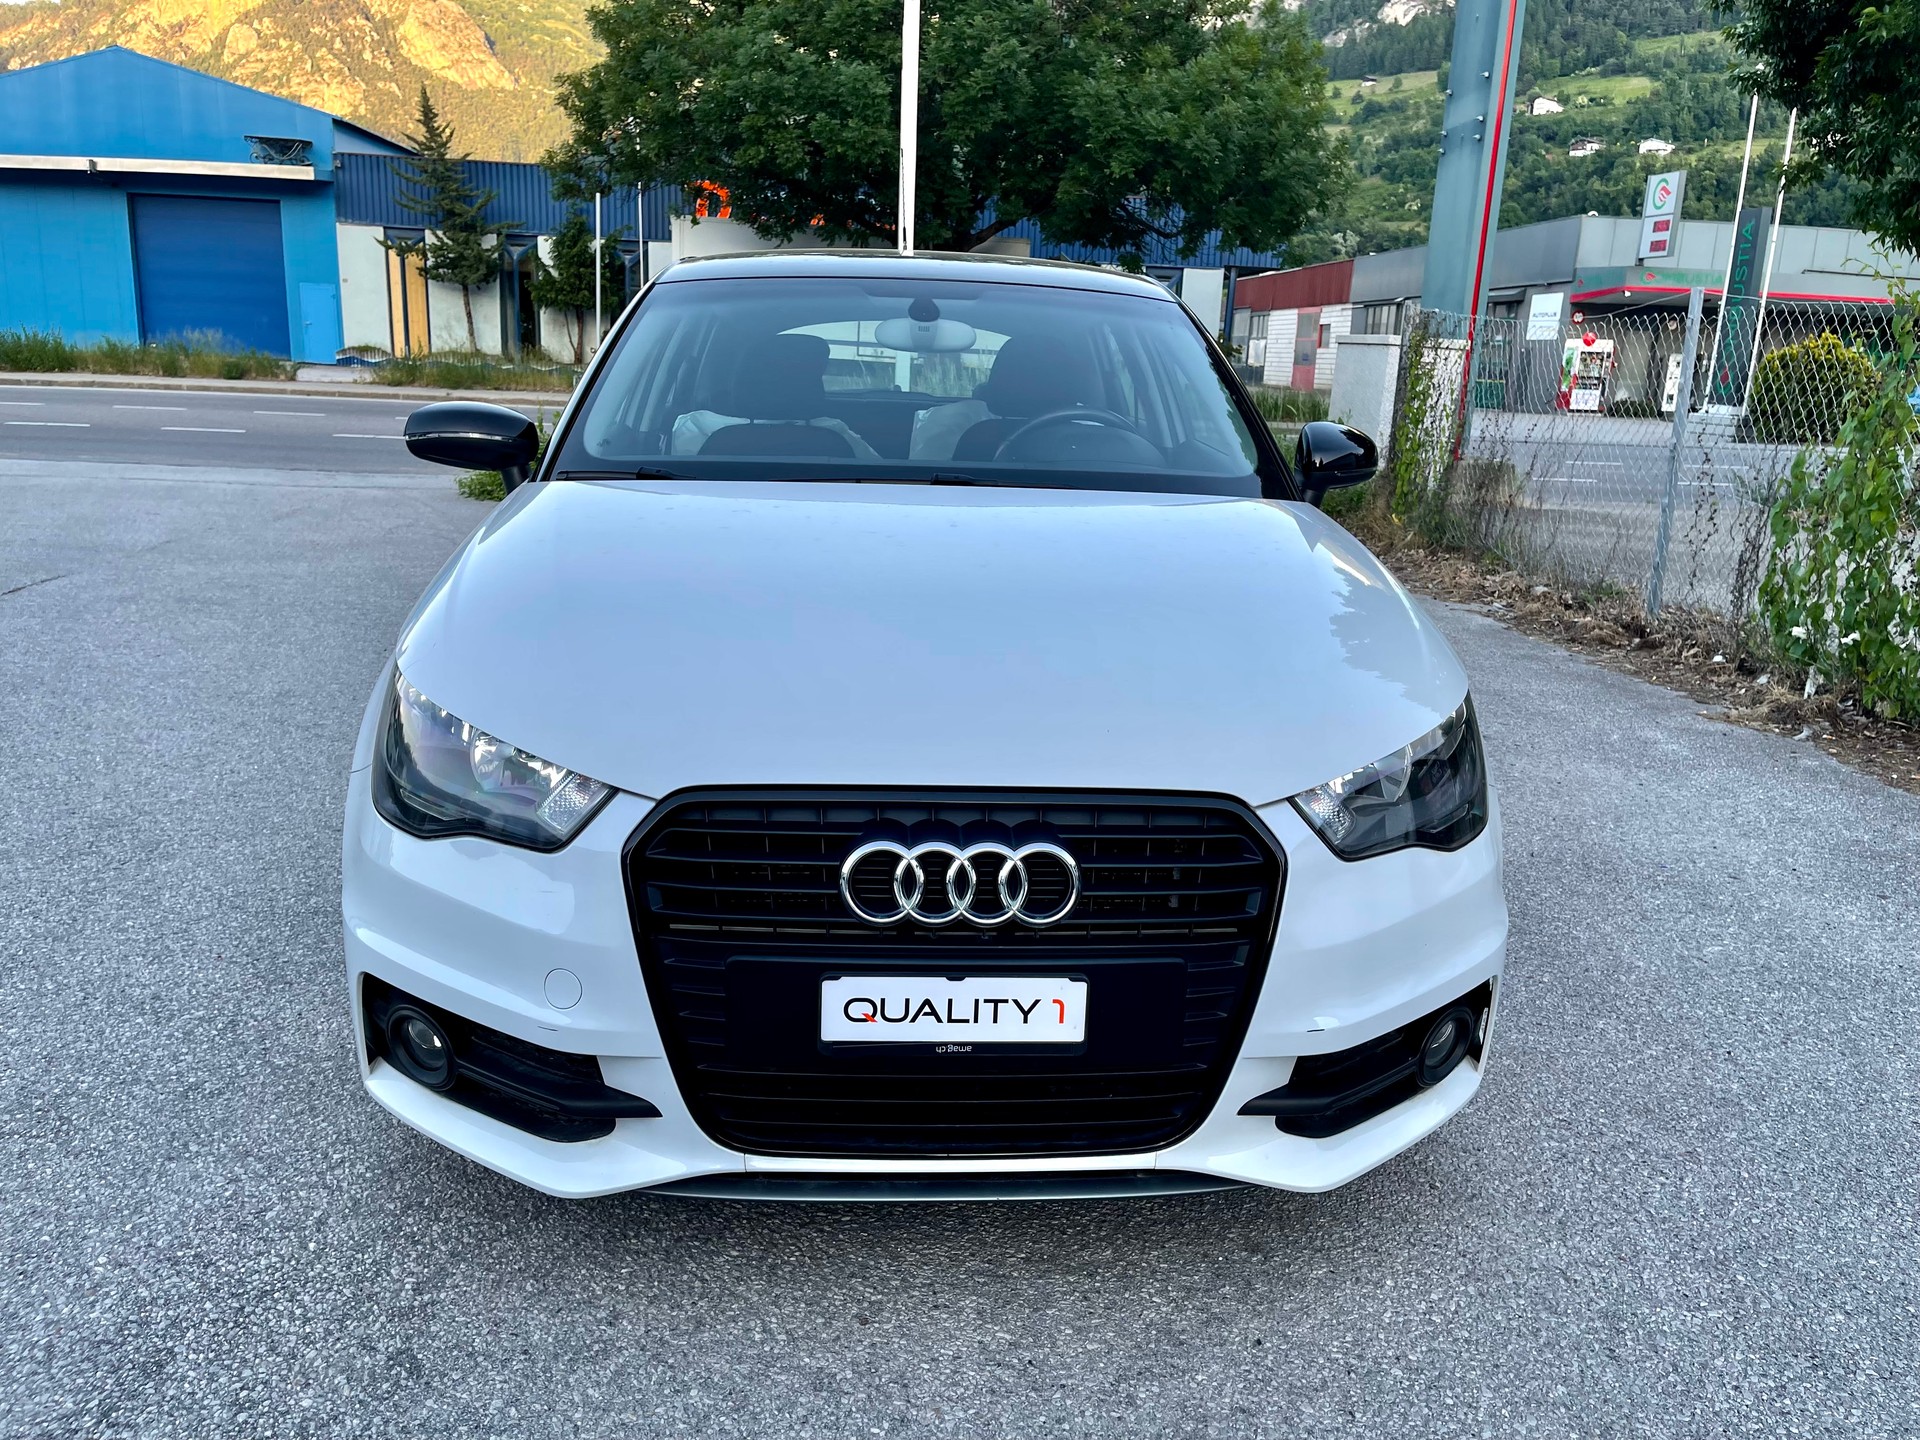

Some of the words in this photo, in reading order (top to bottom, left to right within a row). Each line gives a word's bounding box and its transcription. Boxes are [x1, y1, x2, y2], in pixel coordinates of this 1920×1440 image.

[843, 998, 1042, 1024] QUALITY
[1052, 999, 1065, 1024] 1
[935, 1044, 972, 1053] amag.ch
